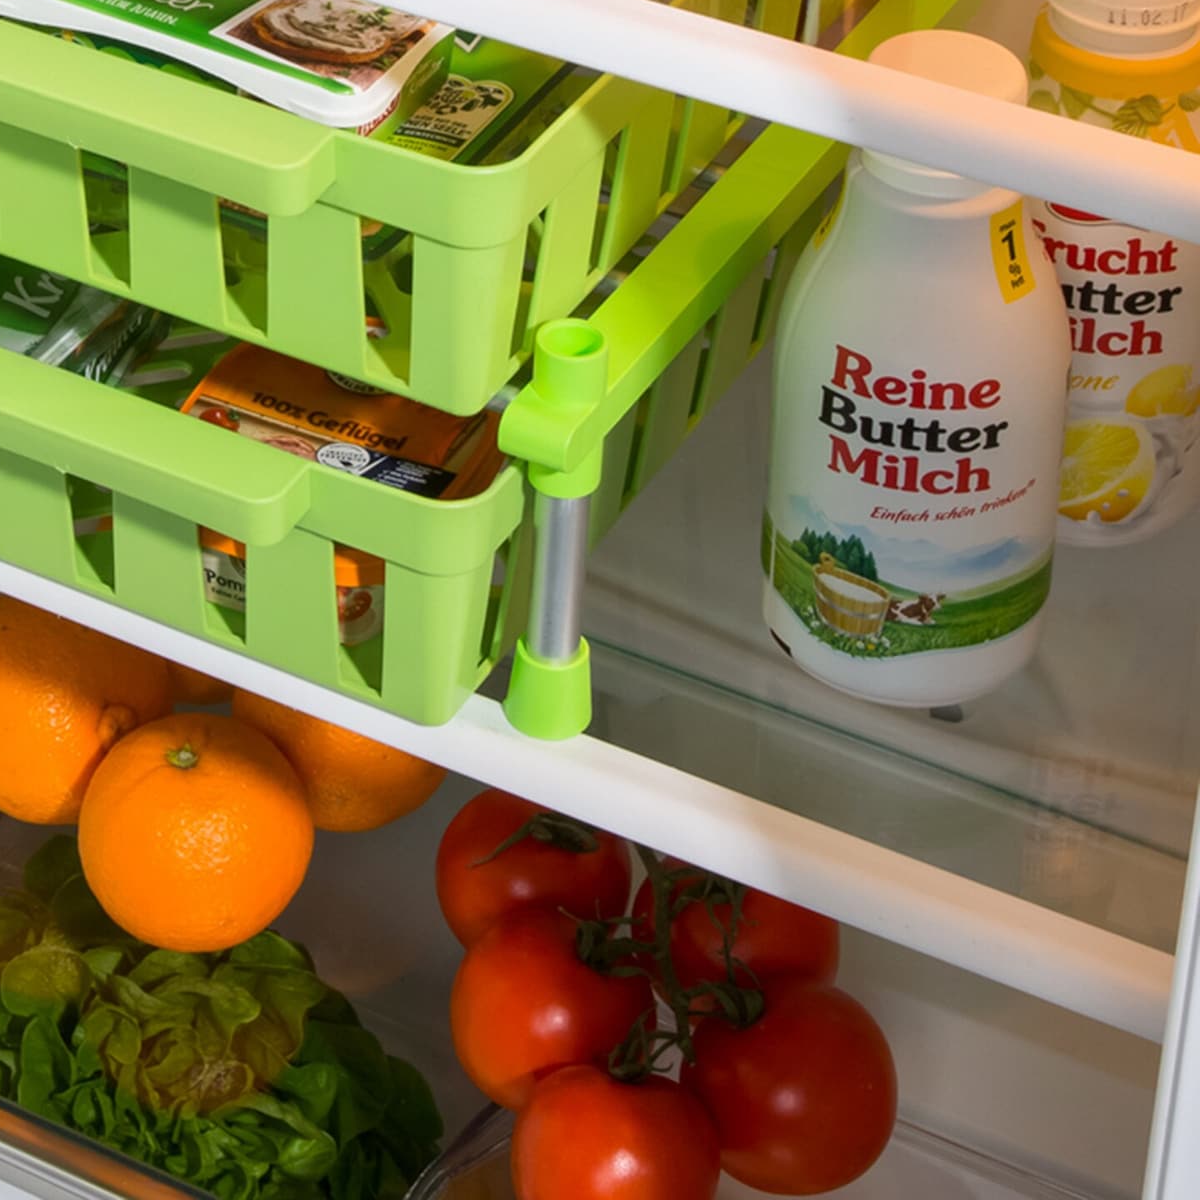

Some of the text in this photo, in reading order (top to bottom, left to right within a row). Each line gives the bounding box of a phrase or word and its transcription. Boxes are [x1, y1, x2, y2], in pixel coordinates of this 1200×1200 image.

[1107, 1, 1189, 26] 11.02.17
[1000, 229, 1017, 262] 1
[1069, 316, 1164, 357] ilch
[830, 343, 1001, 411] Reine
[252, 390, 409, 451] 100% Geflügel
[818, 384, 1009, 454] Butter
[826, 433, 992, 496] Milch
[869, 504, 931, 524] Einfach
[933, 504, 976, 522] schön
